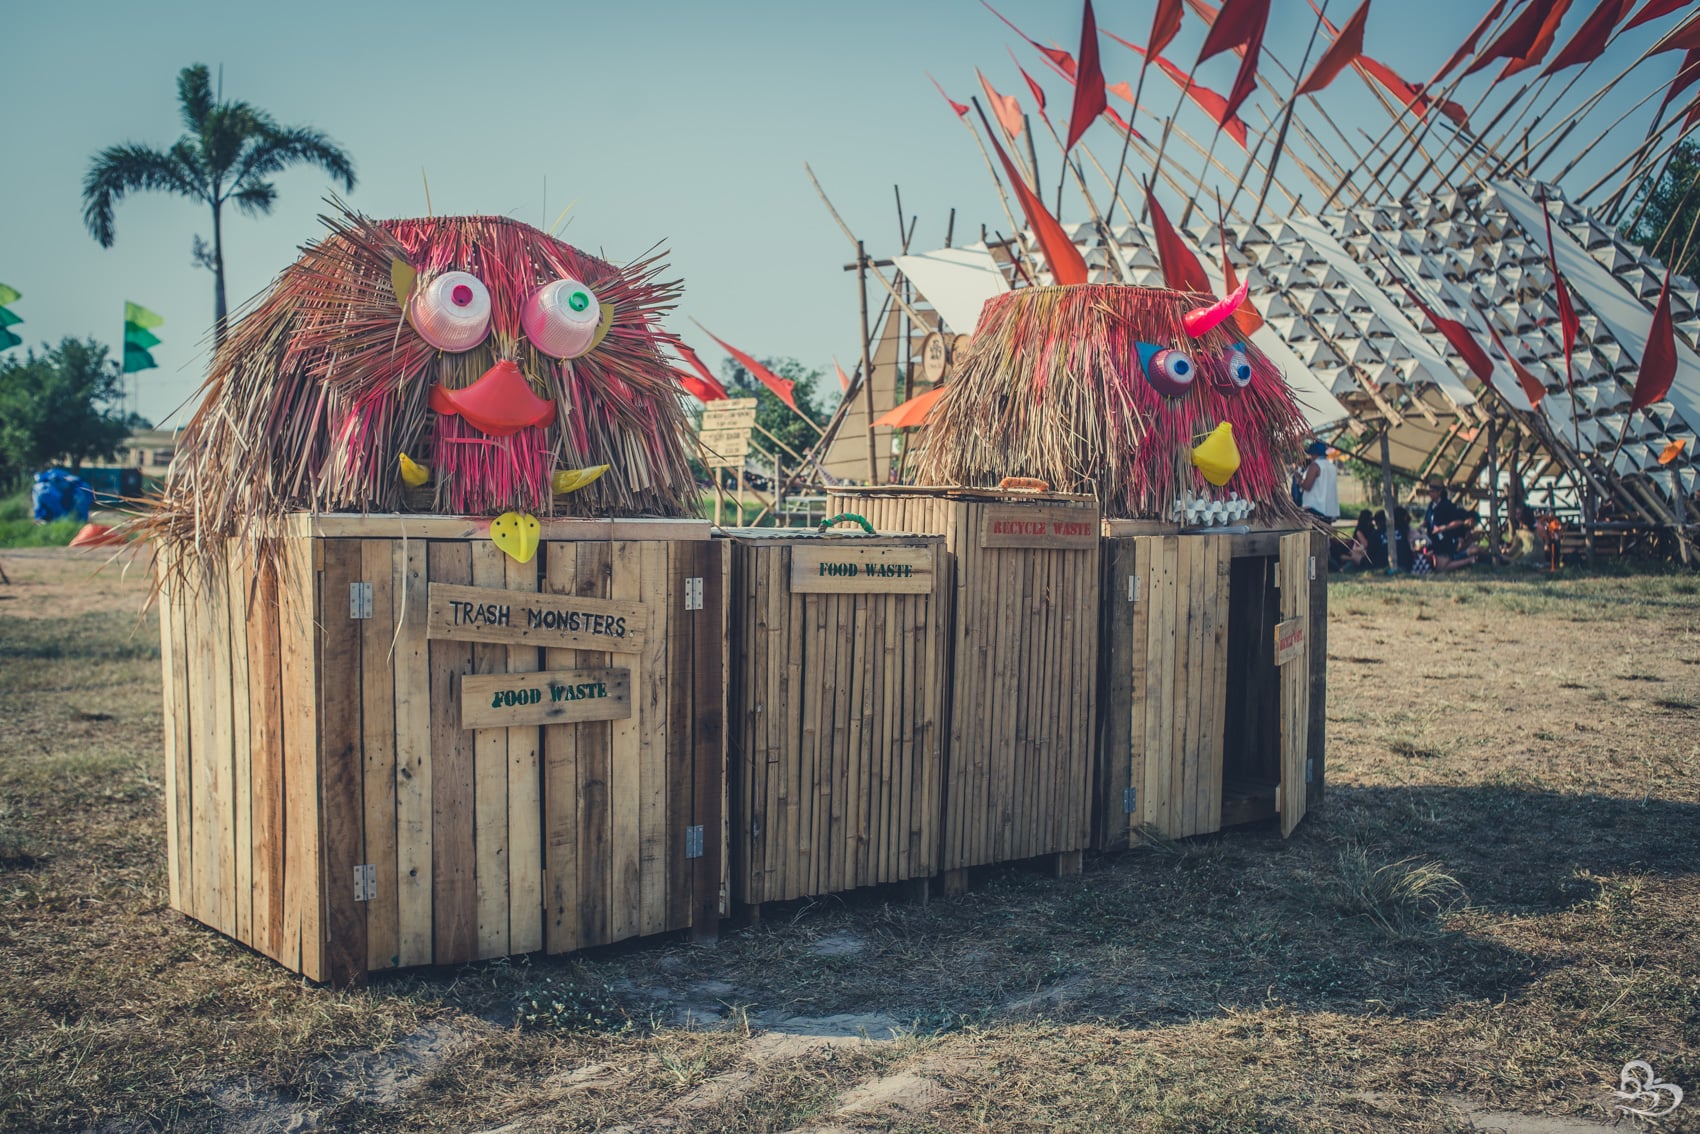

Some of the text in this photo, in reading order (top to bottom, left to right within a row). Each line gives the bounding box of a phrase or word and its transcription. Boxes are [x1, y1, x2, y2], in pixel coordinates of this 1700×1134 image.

[993, 521, 1091, 536] RECYCLE WASTE
[819, 562, 913, 578] FOOD WASTE
[450, 600, 626, 638] TRASH MONSTERS
[491, 682, 608, 708] FOOD WASTE
